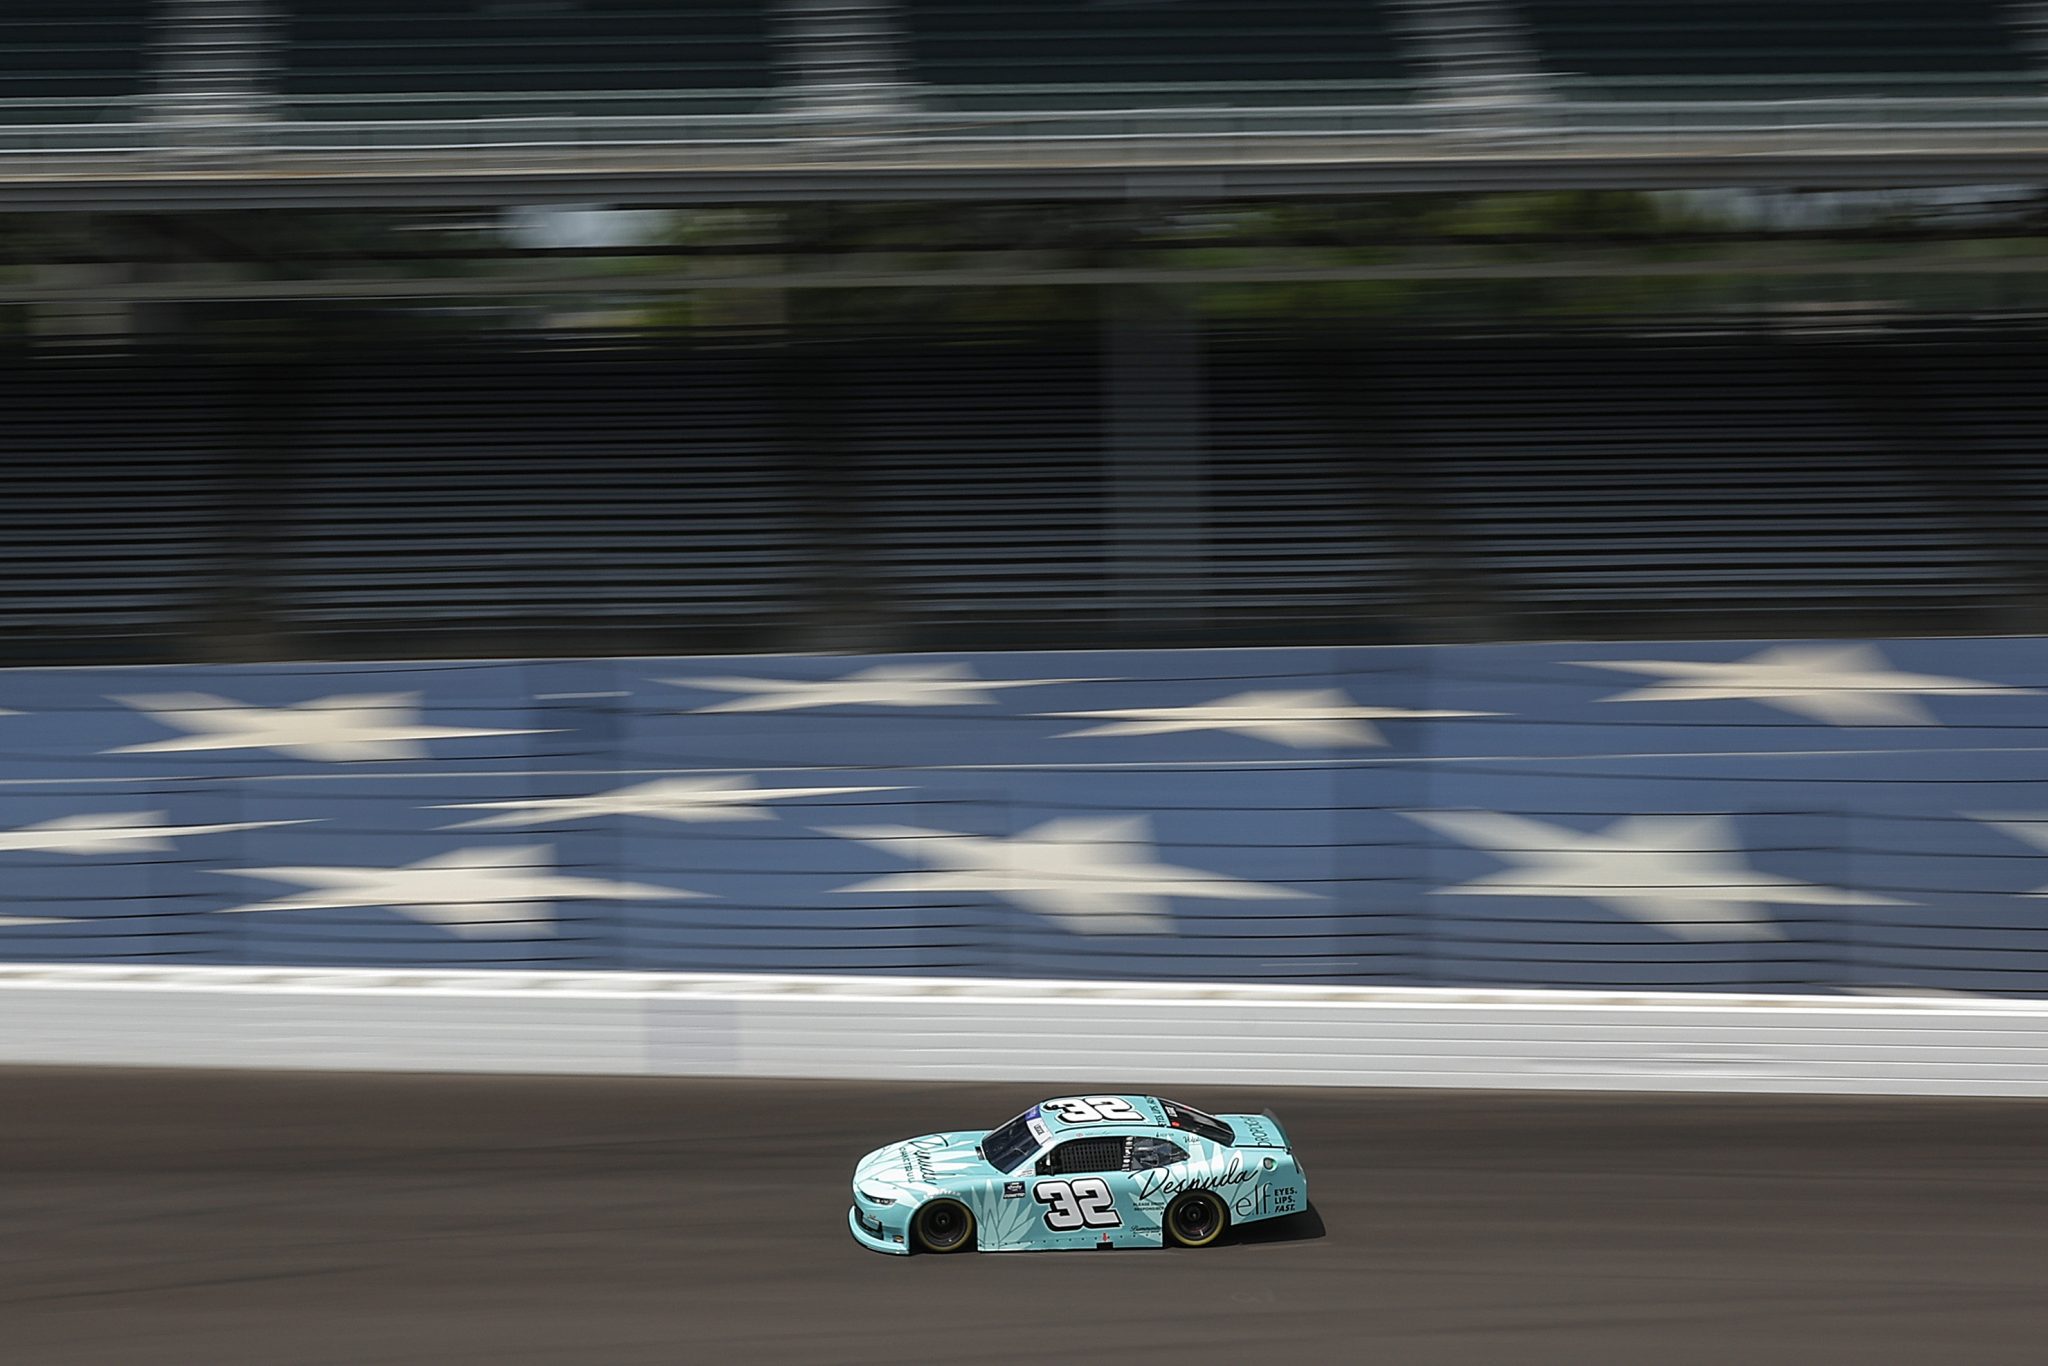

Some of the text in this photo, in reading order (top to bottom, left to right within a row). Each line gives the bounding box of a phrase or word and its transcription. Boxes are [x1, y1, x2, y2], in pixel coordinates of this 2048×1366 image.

[1042, 1096, 1145, 1123] 32
[1274, 1187, 1298, 1196] EYES.
[1033, 1178, 1122, 1231] 32
[1275, 1196, 1296, 1204] LIPS.
[1275, 1204, 1296, 1213] FAST.
